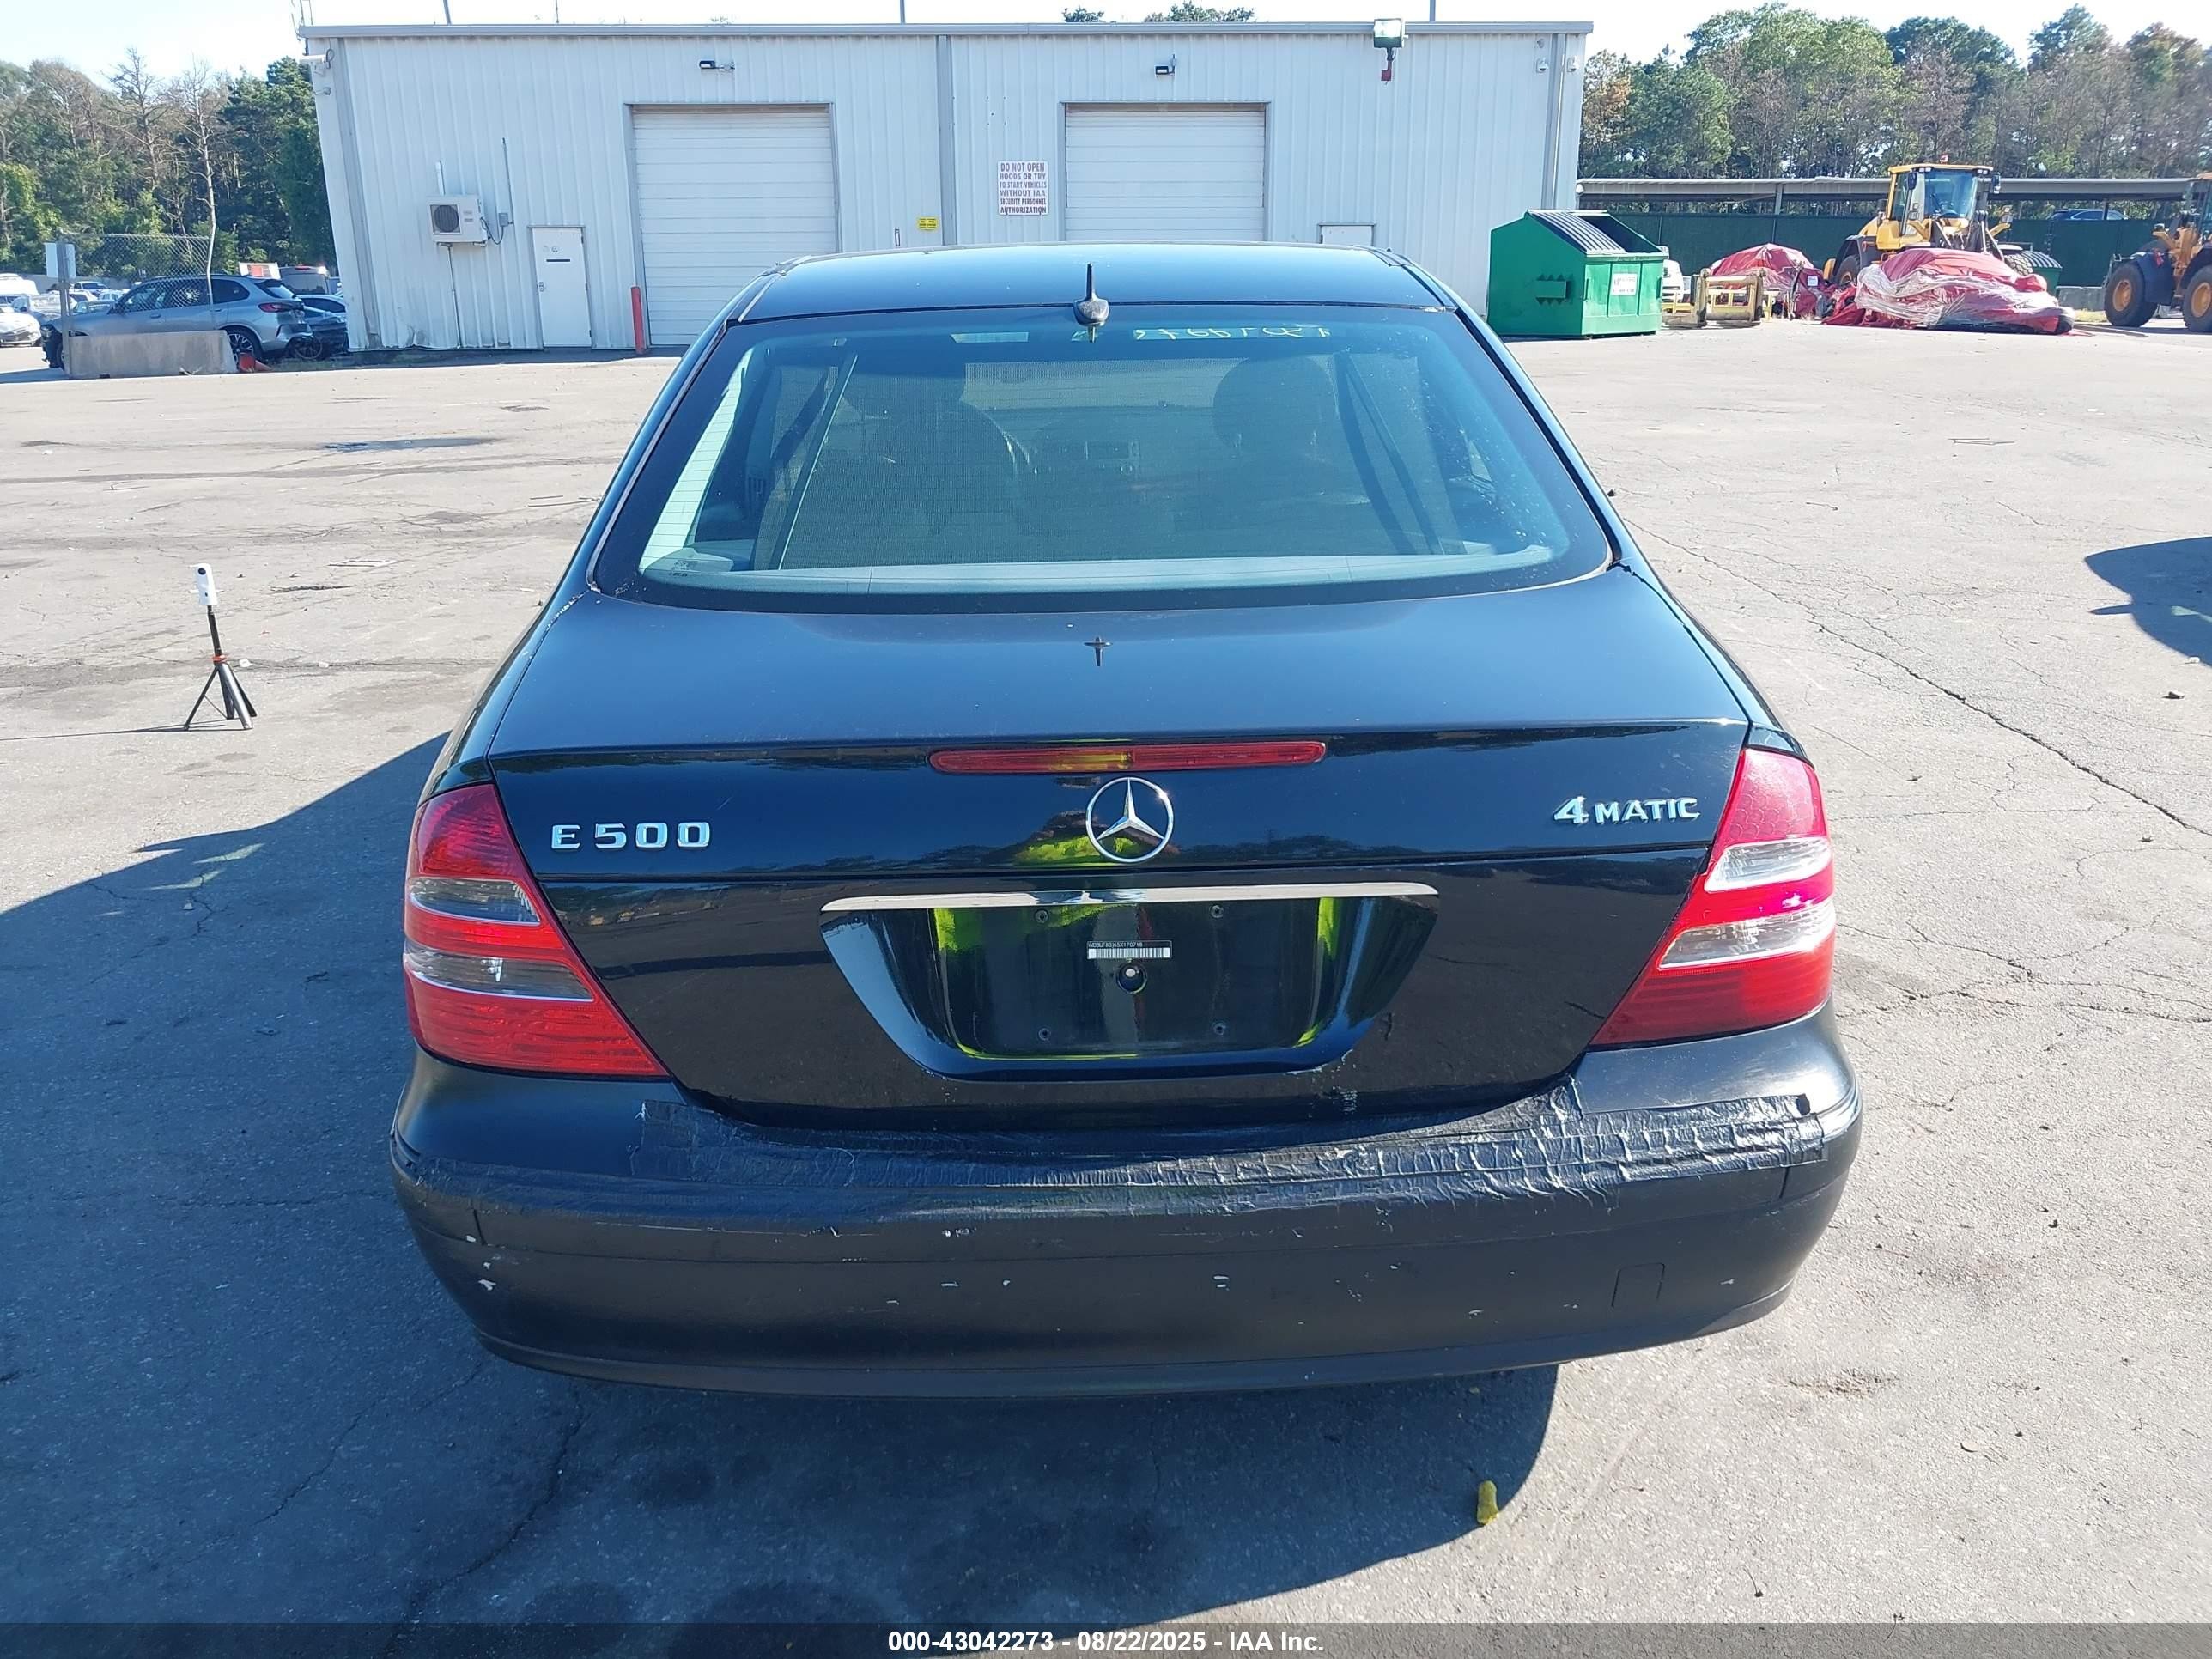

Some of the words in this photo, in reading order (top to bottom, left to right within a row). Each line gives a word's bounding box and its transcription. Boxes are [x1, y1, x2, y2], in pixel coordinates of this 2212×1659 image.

[1000, 162, 1011, 173] DO
[1012, 162, 1025, 173] NOT
[1026, 162, 1045, 173] OPEN
[1000, 189, 1031, 198] WITHOUT
[1033, 189, 1046, 198] IAA
